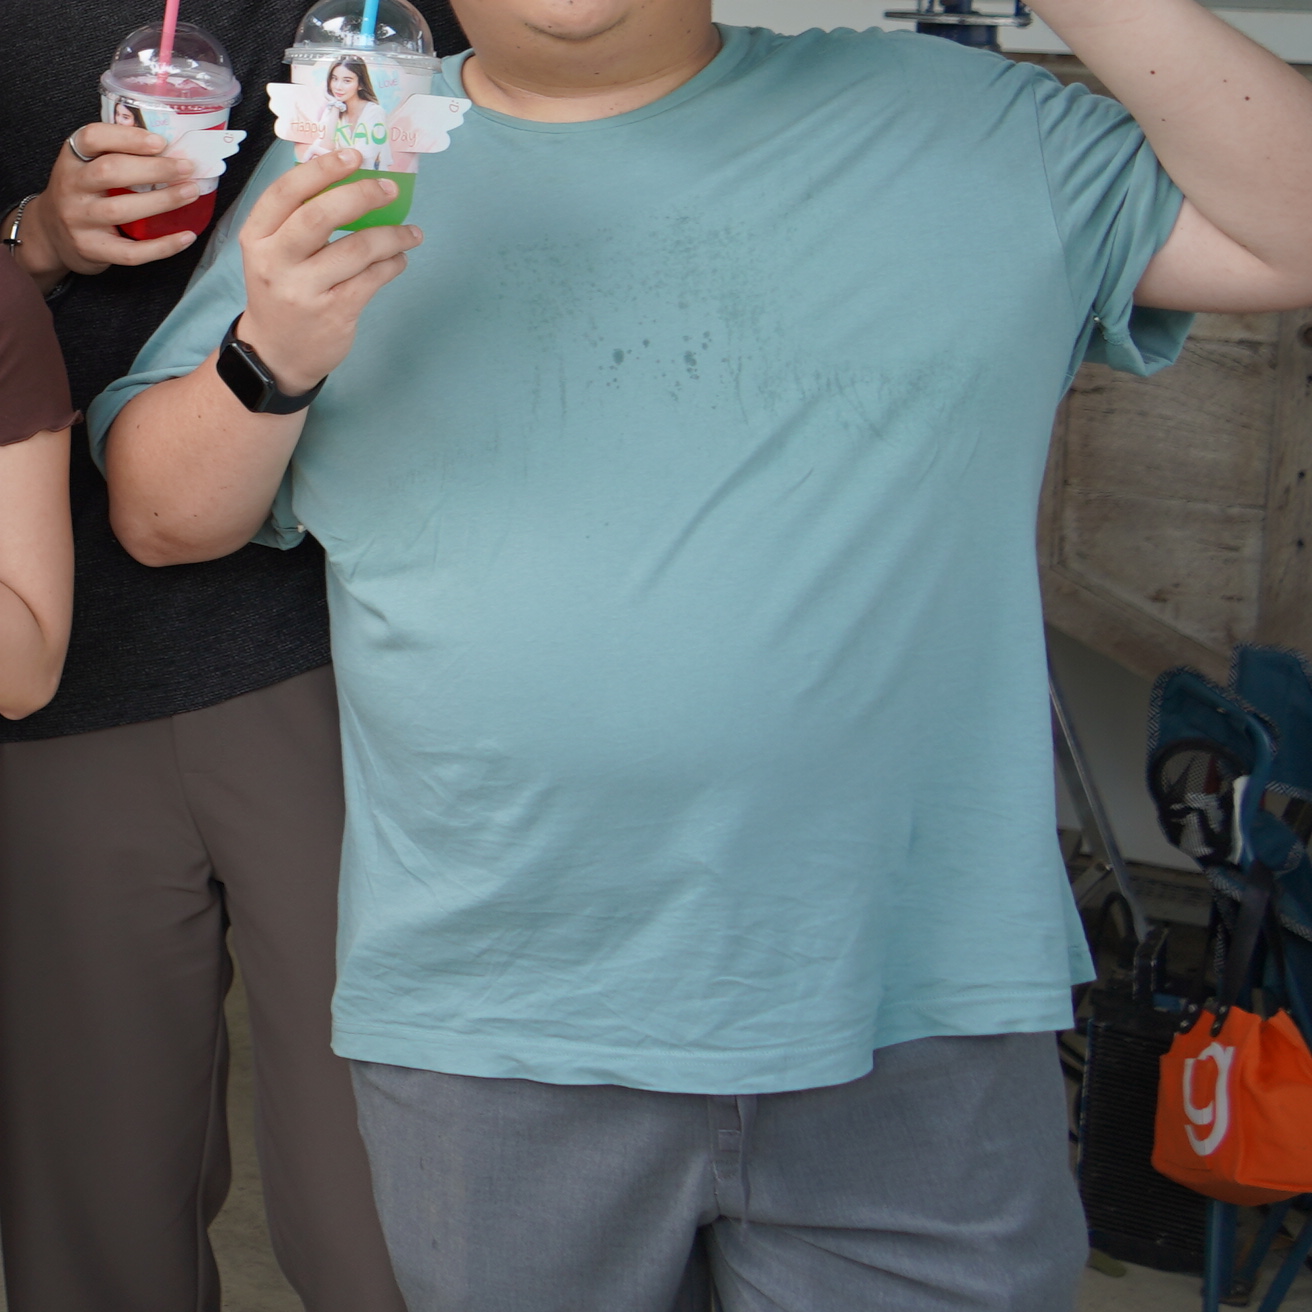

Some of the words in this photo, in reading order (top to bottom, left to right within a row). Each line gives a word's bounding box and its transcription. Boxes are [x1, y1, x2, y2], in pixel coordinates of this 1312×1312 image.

[378, 79, 398, 89] LOVE
[291, 118, 326, 139] Happy
[334, 119, 388, 147] KAO
[391, 126, 417, 148] Day
[1183, 1041, 1235, 1156] g
